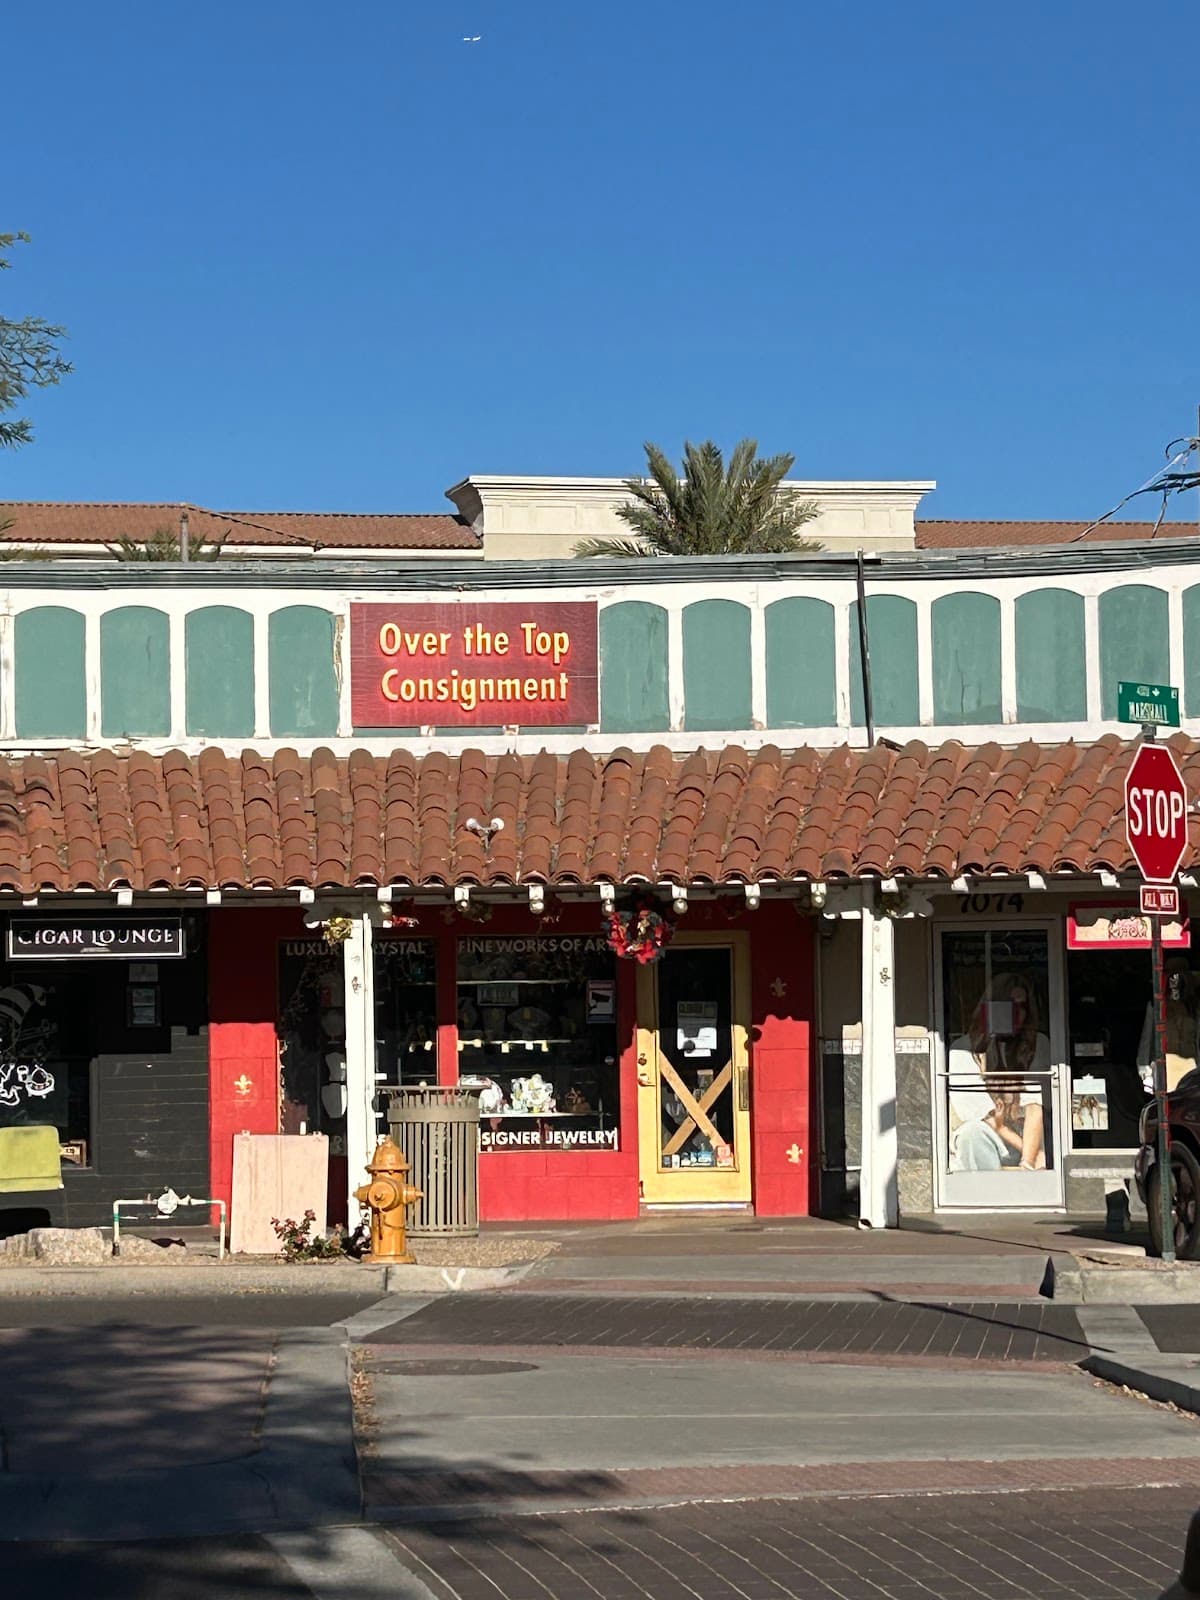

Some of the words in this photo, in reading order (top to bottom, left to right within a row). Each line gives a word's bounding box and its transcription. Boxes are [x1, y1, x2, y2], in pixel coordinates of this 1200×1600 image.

[379, 622, 451, 655] Over
[464, 622, 510, 655] the
[520, 622, 570, 664] Top
[381, 668, 569, 711] Consignment
[1130, 786, 1183, 839] STOP
[958, 893, 1023, 913] 7074
[1144, 891, 1157, 908] ALL
[1160, 892, 1175, 909] WAY
[17, 929, 85, 945] CIGAR
[91, 928, 174, 947] LOUNGE
[458, 939, 493, 953] FINE
[496, 938, 559, 953] WORKS
[560, 937, 583, 952] OF
[584, 937, 609, 952] AR
[286, 941, 340, 956] LUXUR
[373, 940, 426, 955] YSTAL
[481, 1131, 541, 1146] SIGNER
[545, 1130, 615, 1145] JEWELRY
